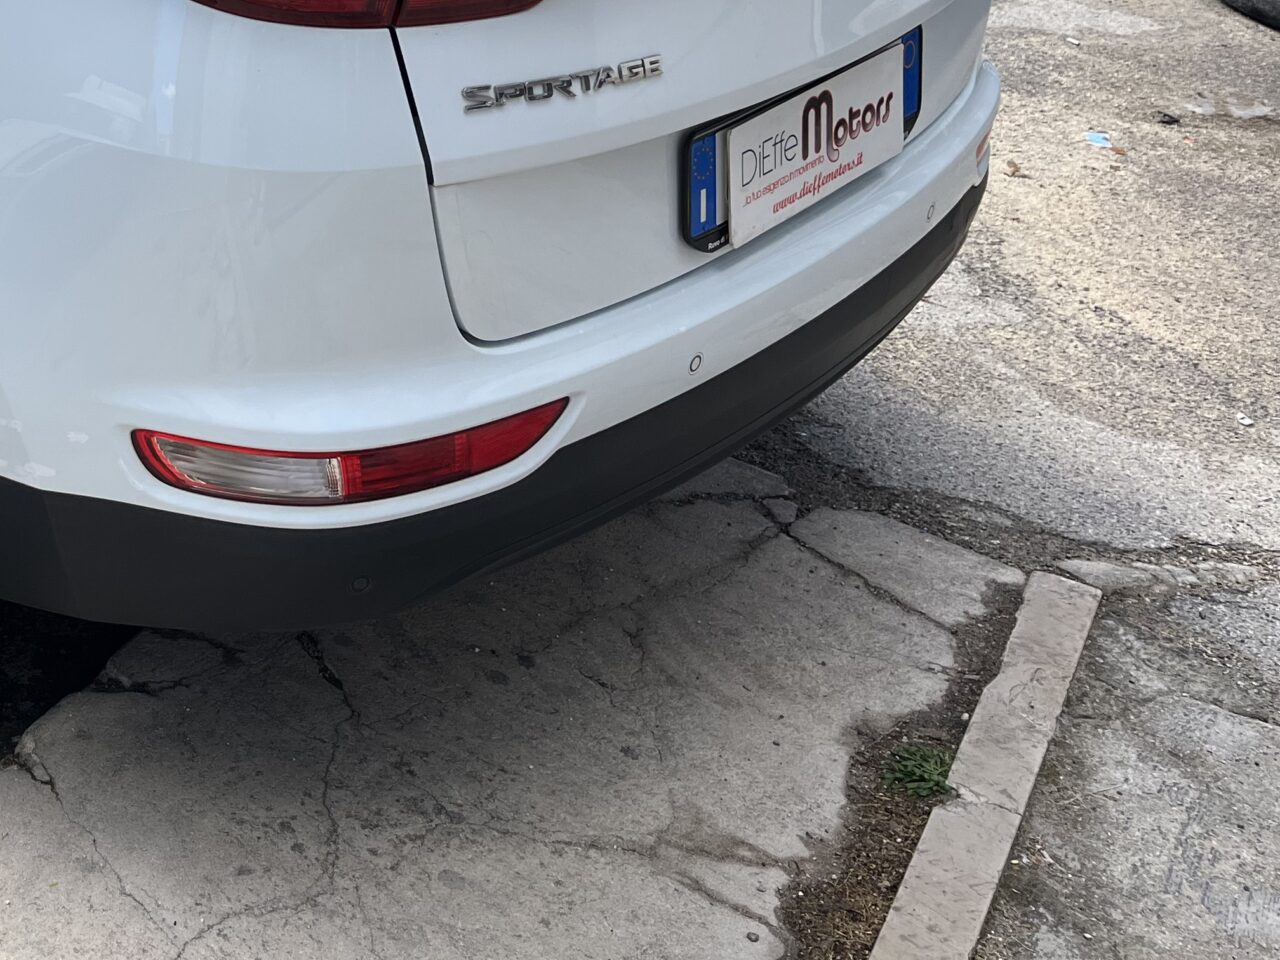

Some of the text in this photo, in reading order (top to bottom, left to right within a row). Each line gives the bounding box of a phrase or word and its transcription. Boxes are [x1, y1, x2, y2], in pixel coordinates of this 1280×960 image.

[461, 54, 663, 113] SPORTAGE
[741, 89, 894, 187] DiEffe Motors
[772, 151, 864, 214] www.dieffemotors.it
